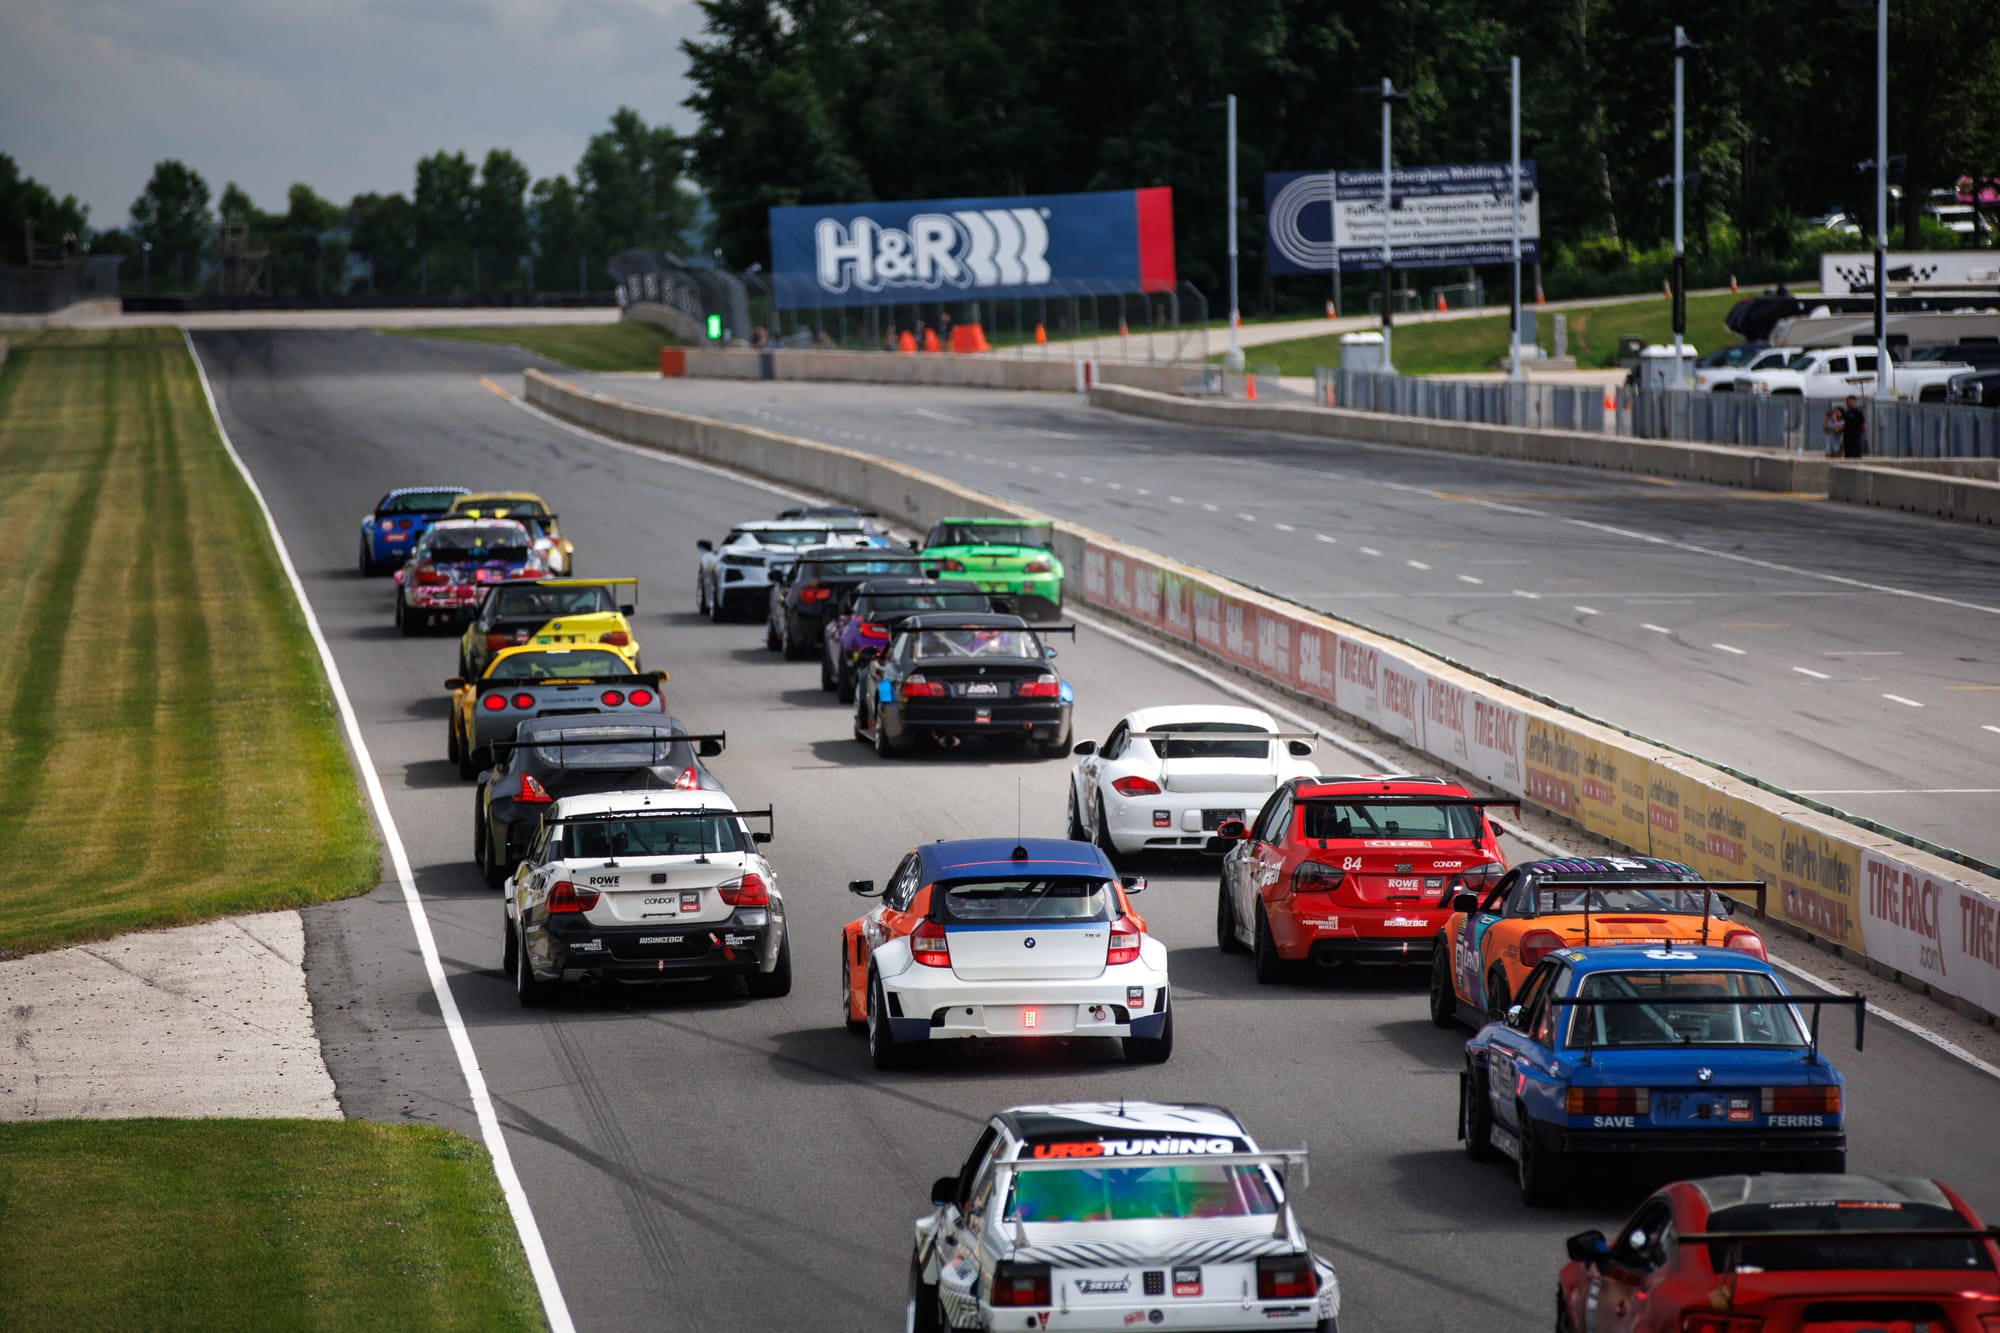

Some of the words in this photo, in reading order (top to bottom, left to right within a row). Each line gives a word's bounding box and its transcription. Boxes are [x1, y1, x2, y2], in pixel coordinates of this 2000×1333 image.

[1507, 164, 1531, 178] Ic.
[1484, 194, 1526, 209] Faciliy
[815, 212, 972, 293] H&R
[1474, 701, 1493, 748] TIRE
[1342, 856, 1362, 871] 84
[1432, 860, 1462, 869] CONDOR
[589, 875, 620, 885] ROWE
[1388, 879, 1419, 888] ROWE
[1867, 860, 1900, 926] TIRE
[644, 897, 675, 905] CONDOR
[1960, 894, 1995, 967] TIRE
[1593, 1116, 1635, 1128] SAVE
[1768, 1115, 1823, 1127] FERRIS
